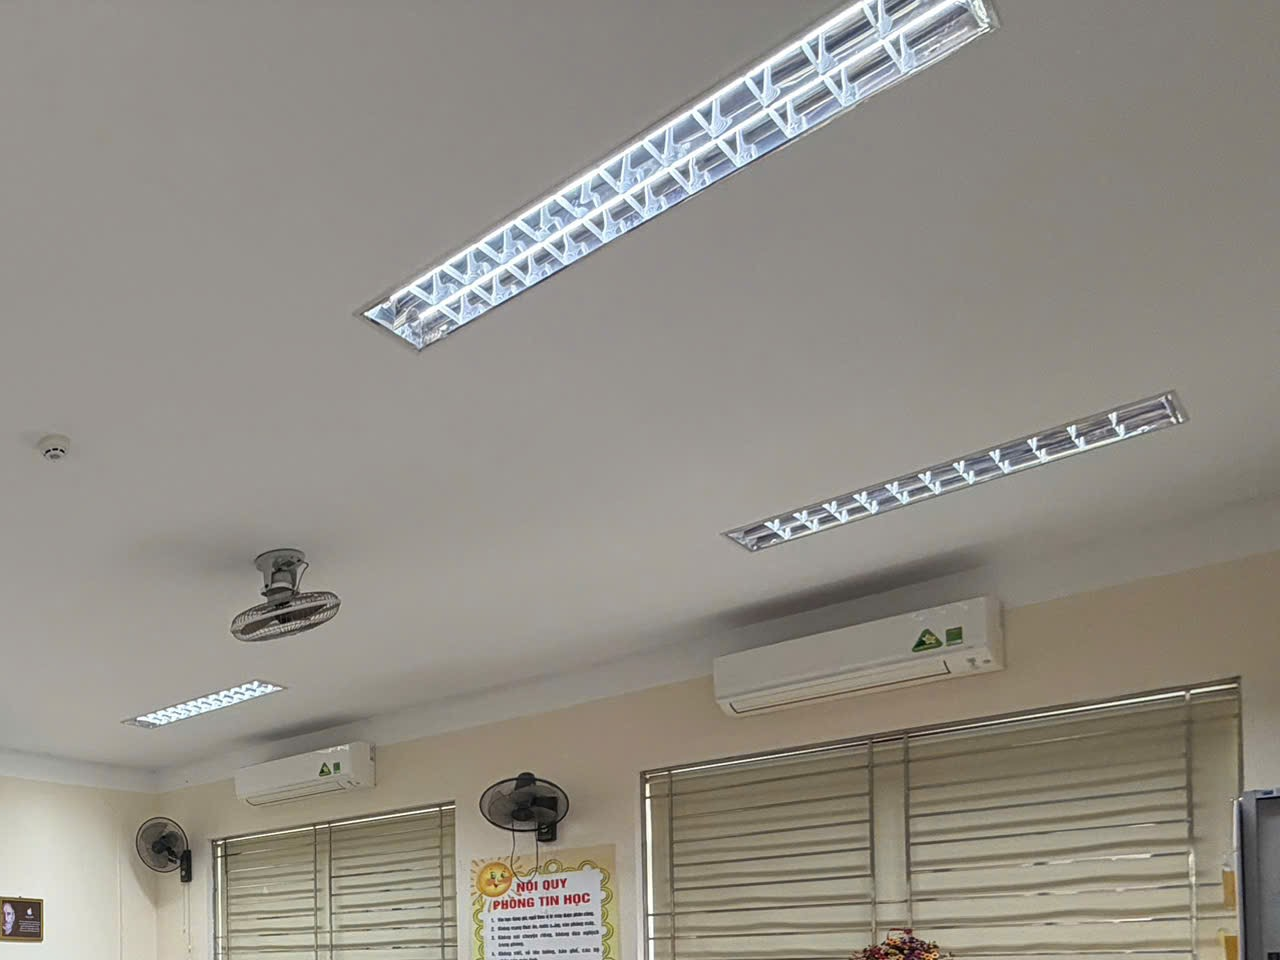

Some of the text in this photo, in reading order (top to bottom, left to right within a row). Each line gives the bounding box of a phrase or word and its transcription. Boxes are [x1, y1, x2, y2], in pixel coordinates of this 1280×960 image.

[516, 878, 568, 894] NỘI QUY
[492, 892, 591, 911] PHÒNG TIN HỌC
